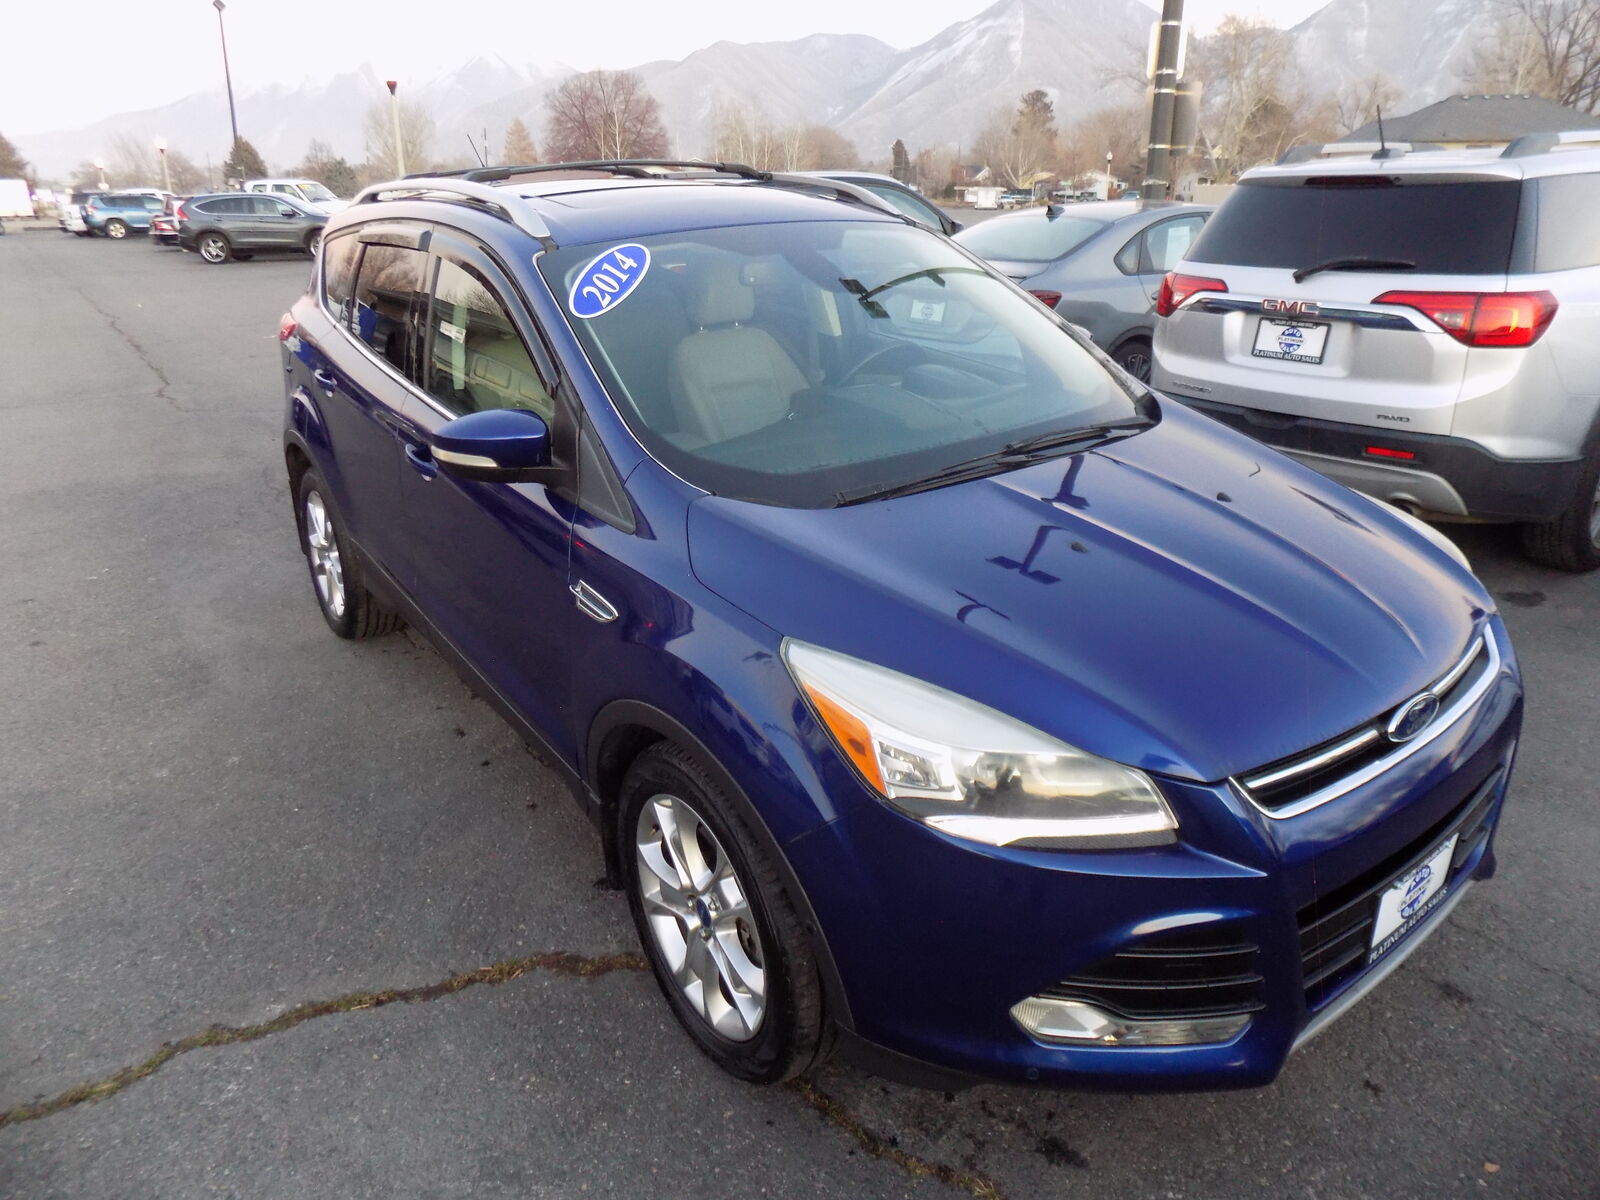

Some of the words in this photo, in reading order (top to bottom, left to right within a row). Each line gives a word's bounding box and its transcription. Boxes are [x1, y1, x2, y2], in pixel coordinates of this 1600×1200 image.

[582, 250, 638, 309] 2014
[1263, 299, 1321, 315] GMC
[1284, 328, 1301, 336] AUTO
[1253, 350, 1283, 358] PLATINUM
[1284, 353, 1301, 361] AUTO
[1376, 414, 1410, 422] AWD
